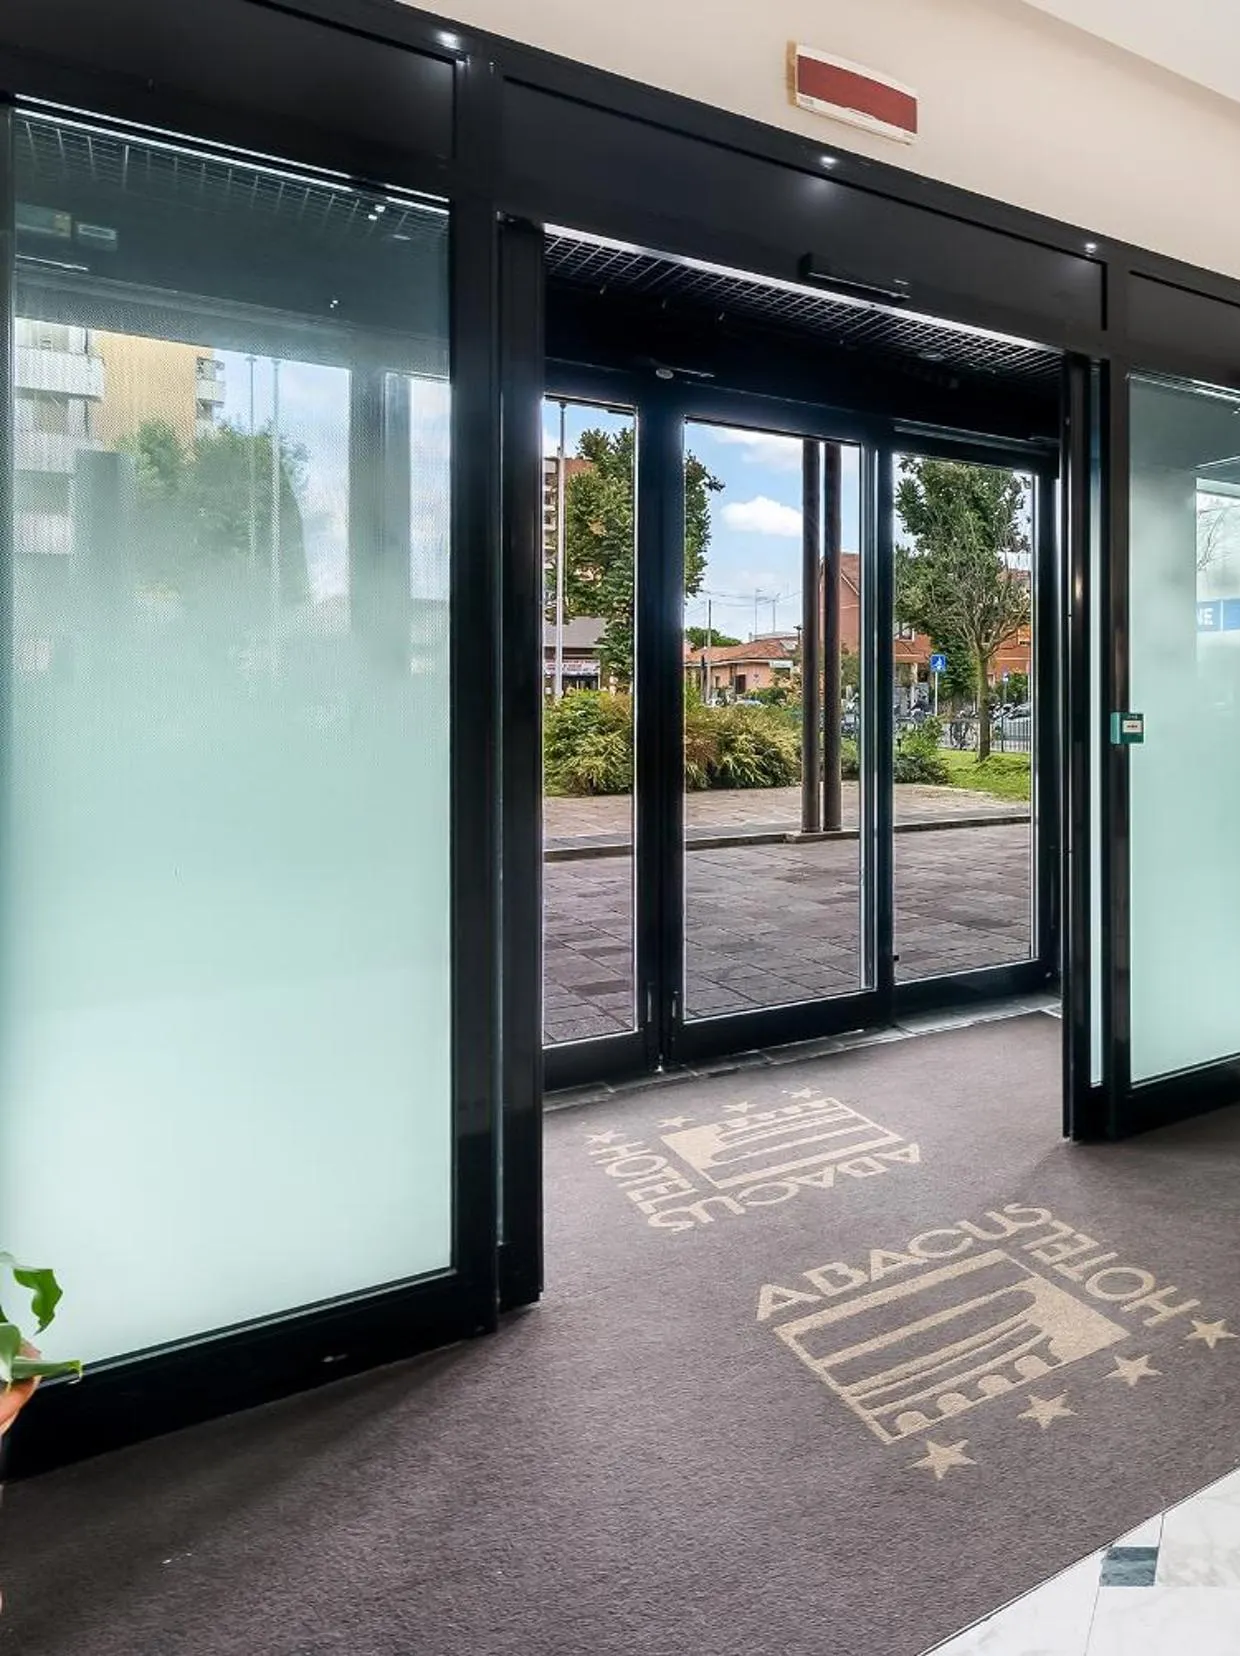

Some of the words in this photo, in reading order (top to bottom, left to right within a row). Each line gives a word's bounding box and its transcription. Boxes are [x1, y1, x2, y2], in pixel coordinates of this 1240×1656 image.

[588, 1140, 699, 1215] HOTEL
[647, 1143, 920, 1234] ABACUS
[756, 1203, 1052, 1321] ABACUS
[1022, 1220, 1200, 1327] HOTEL
